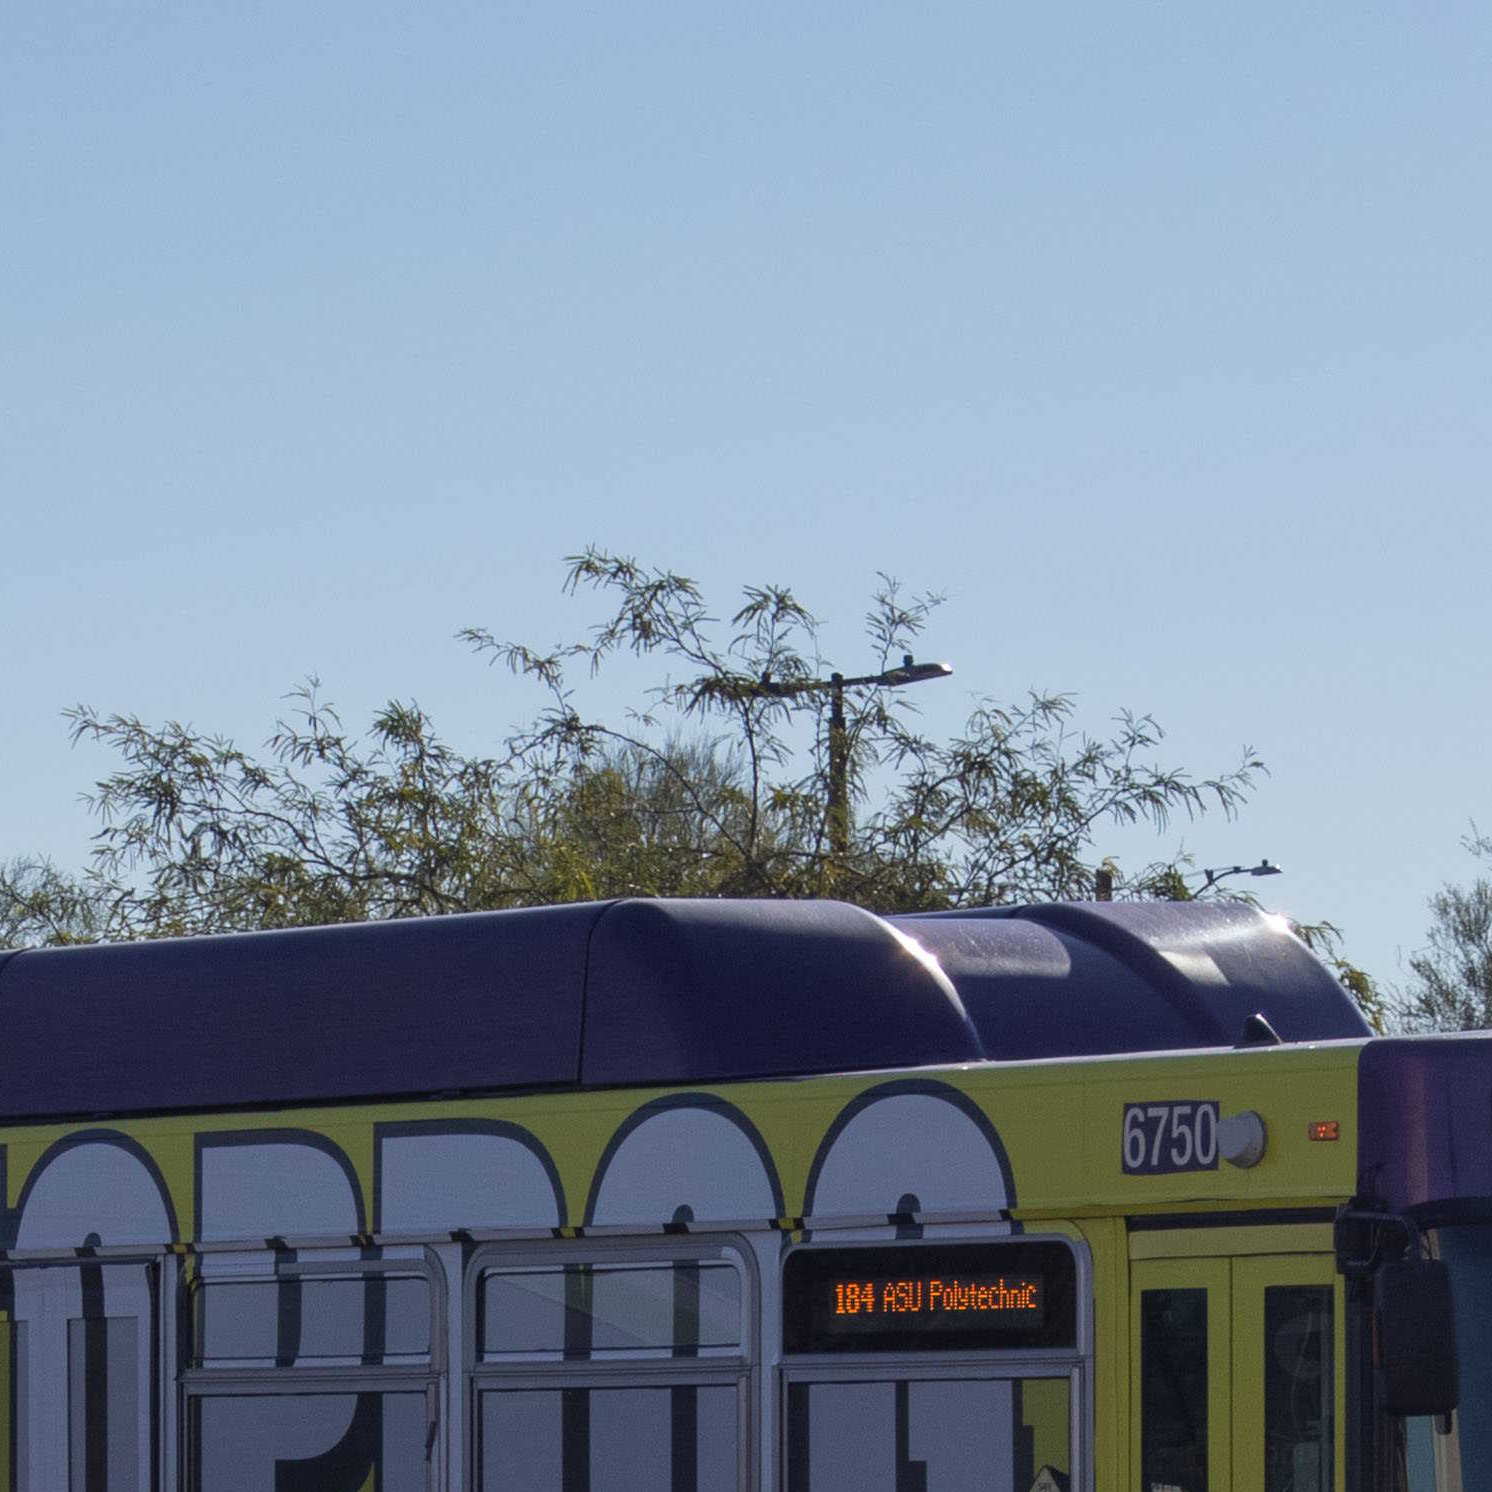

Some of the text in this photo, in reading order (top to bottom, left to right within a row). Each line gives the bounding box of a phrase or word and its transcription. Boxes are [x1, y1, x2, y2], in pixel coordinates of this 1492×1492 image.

[1124, 1104, 1216, 1168] 6750
[836, 1275, 1037, 1315] 184 ASU Polytechnic
